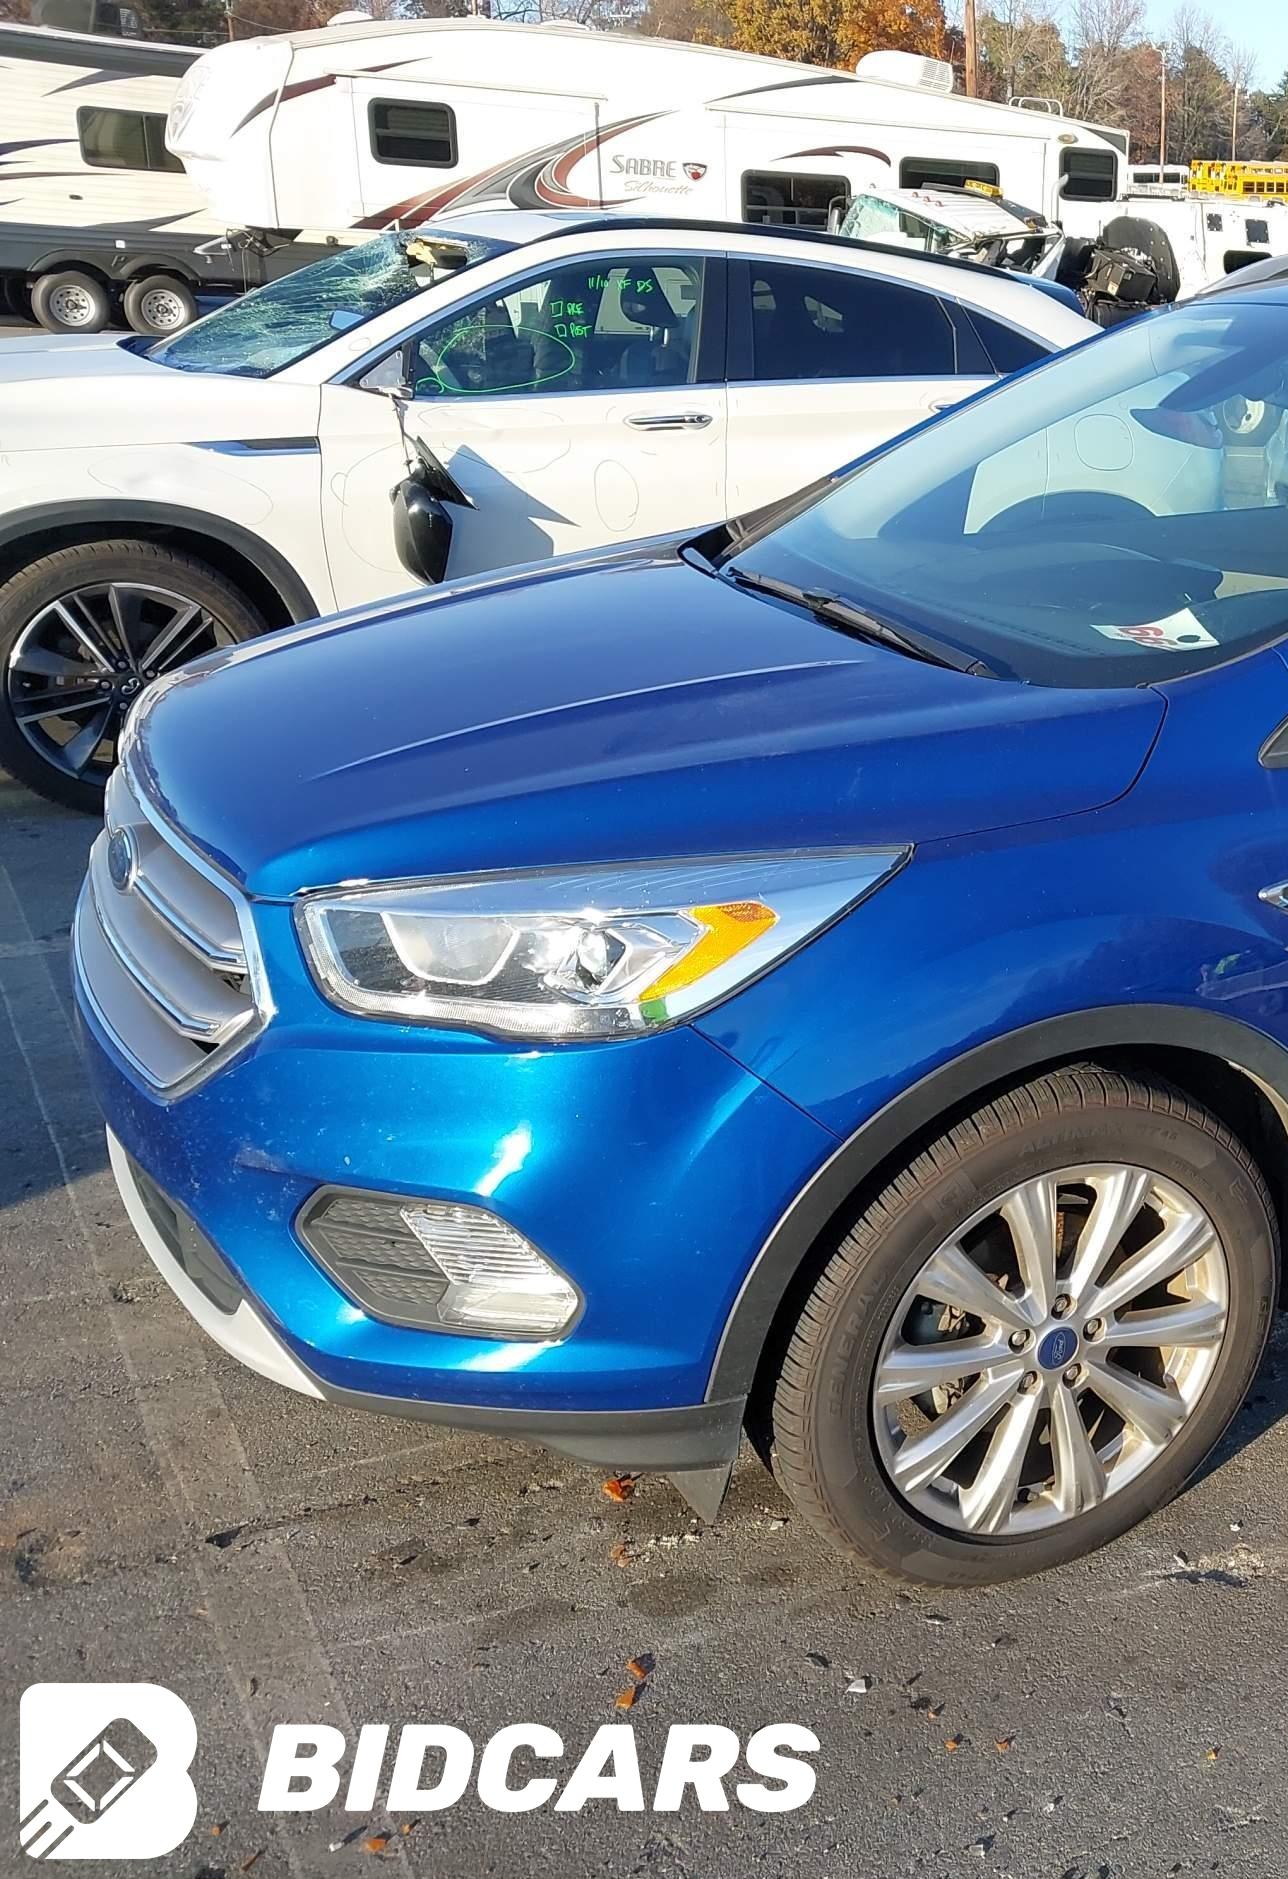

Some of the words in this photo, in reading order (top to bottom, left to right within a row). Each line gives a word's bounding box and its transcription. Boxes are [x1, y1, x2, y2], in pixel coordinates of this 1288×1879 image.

[609, 154, 677, 178] SABRE
[624, 180, 693, 195] Silhouette
[566, 302, 584, 316] PRE
[569, 322, 593, 338] POST
